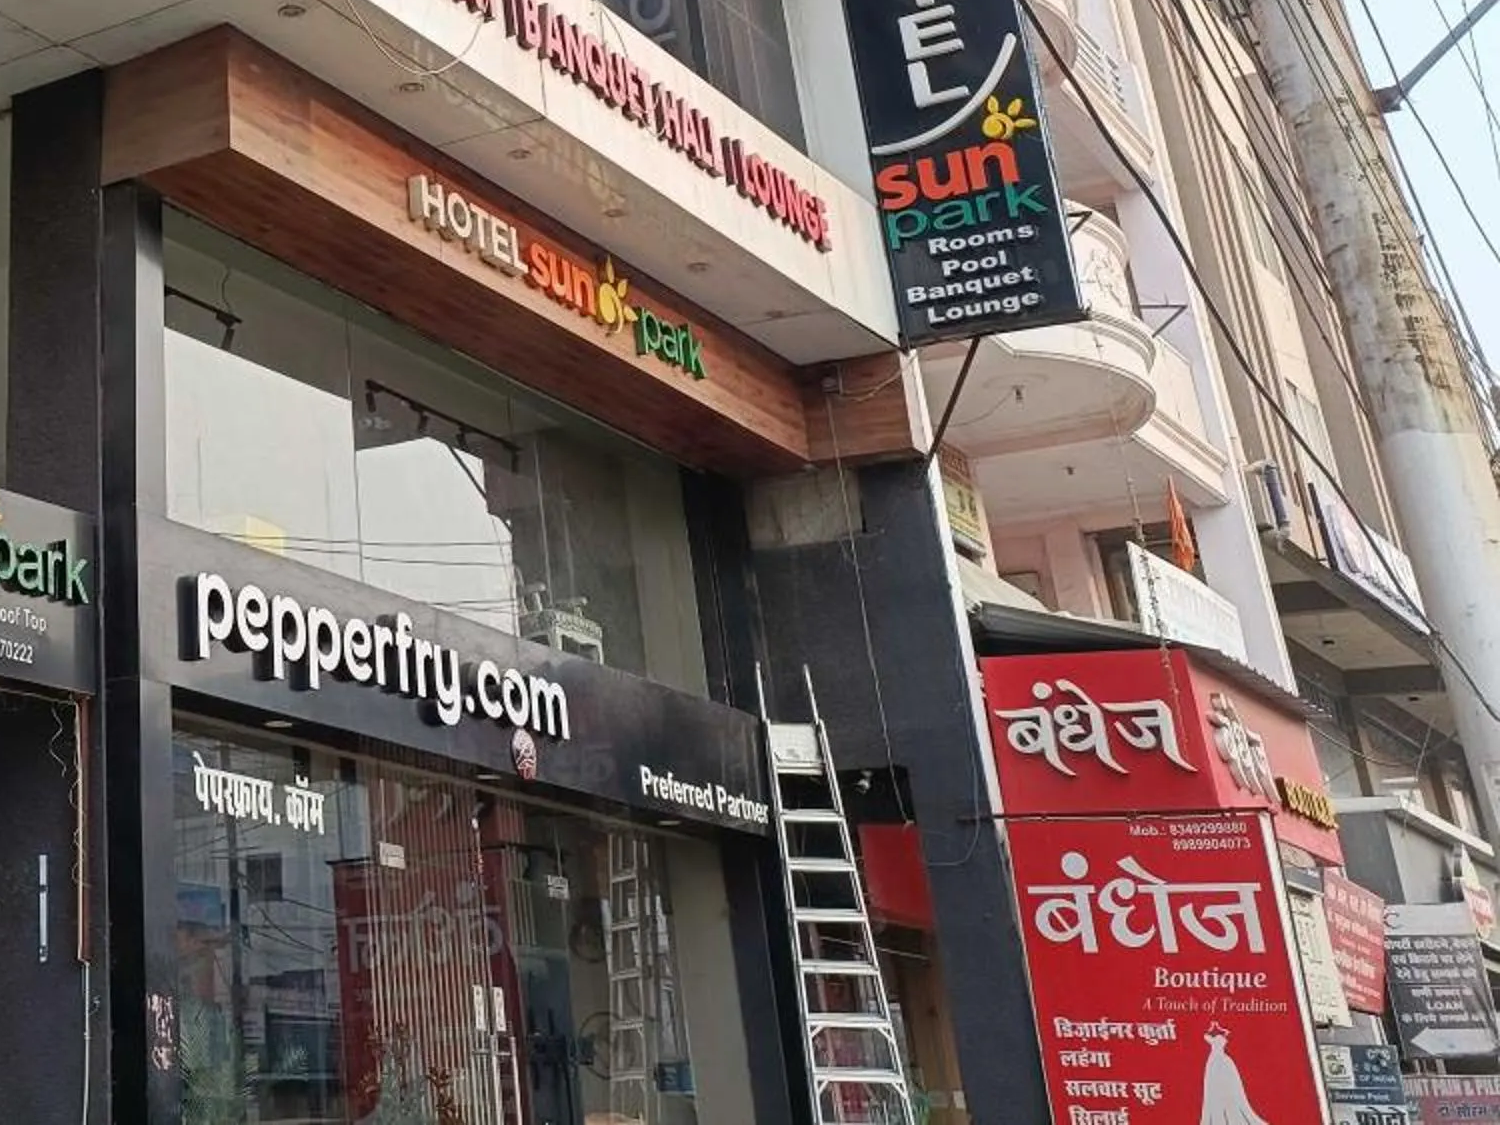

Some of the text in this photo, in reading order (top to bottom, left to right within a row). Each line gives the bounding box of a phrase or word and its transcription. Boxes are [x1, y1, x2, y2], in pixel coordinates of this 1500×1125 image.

[656, 80, 723, 178] HALL
[740, 155, 833, 254] LOUNGE
[876, 141, 1021, 211] sun
[886, 179, 1049, 250] park
[928, 225, 1034, 254] Rooms
[409, 174, 707, 381] HOTEL sun park
[906, 266, 1034, 305] Banquet
[942, 251, 1007, 276] Pool
[927, 289, 1040, 325] Lounge
[23, 608, 48, 633] Top
[197, 572, 571, 741] pepperfry.com
[995, 678, 1199, 777] बंधेज
[284, 774, 326, 837] कॉम
[640, 765, 770, 826] Preferred Partner
[1027, 851, 1267, 955] बंधेज
[1154, 966, 1268, 994] Boutique
[1156, 997, 1199, 1012] Touch
[1203, 998, 1218, 1014] of
[1222, 999, 1288, 1013] Tradition
[1058, 1047, 1112, 1068] लहंगा
[1063, 1080, 1163, 1106] सलवार सूट
